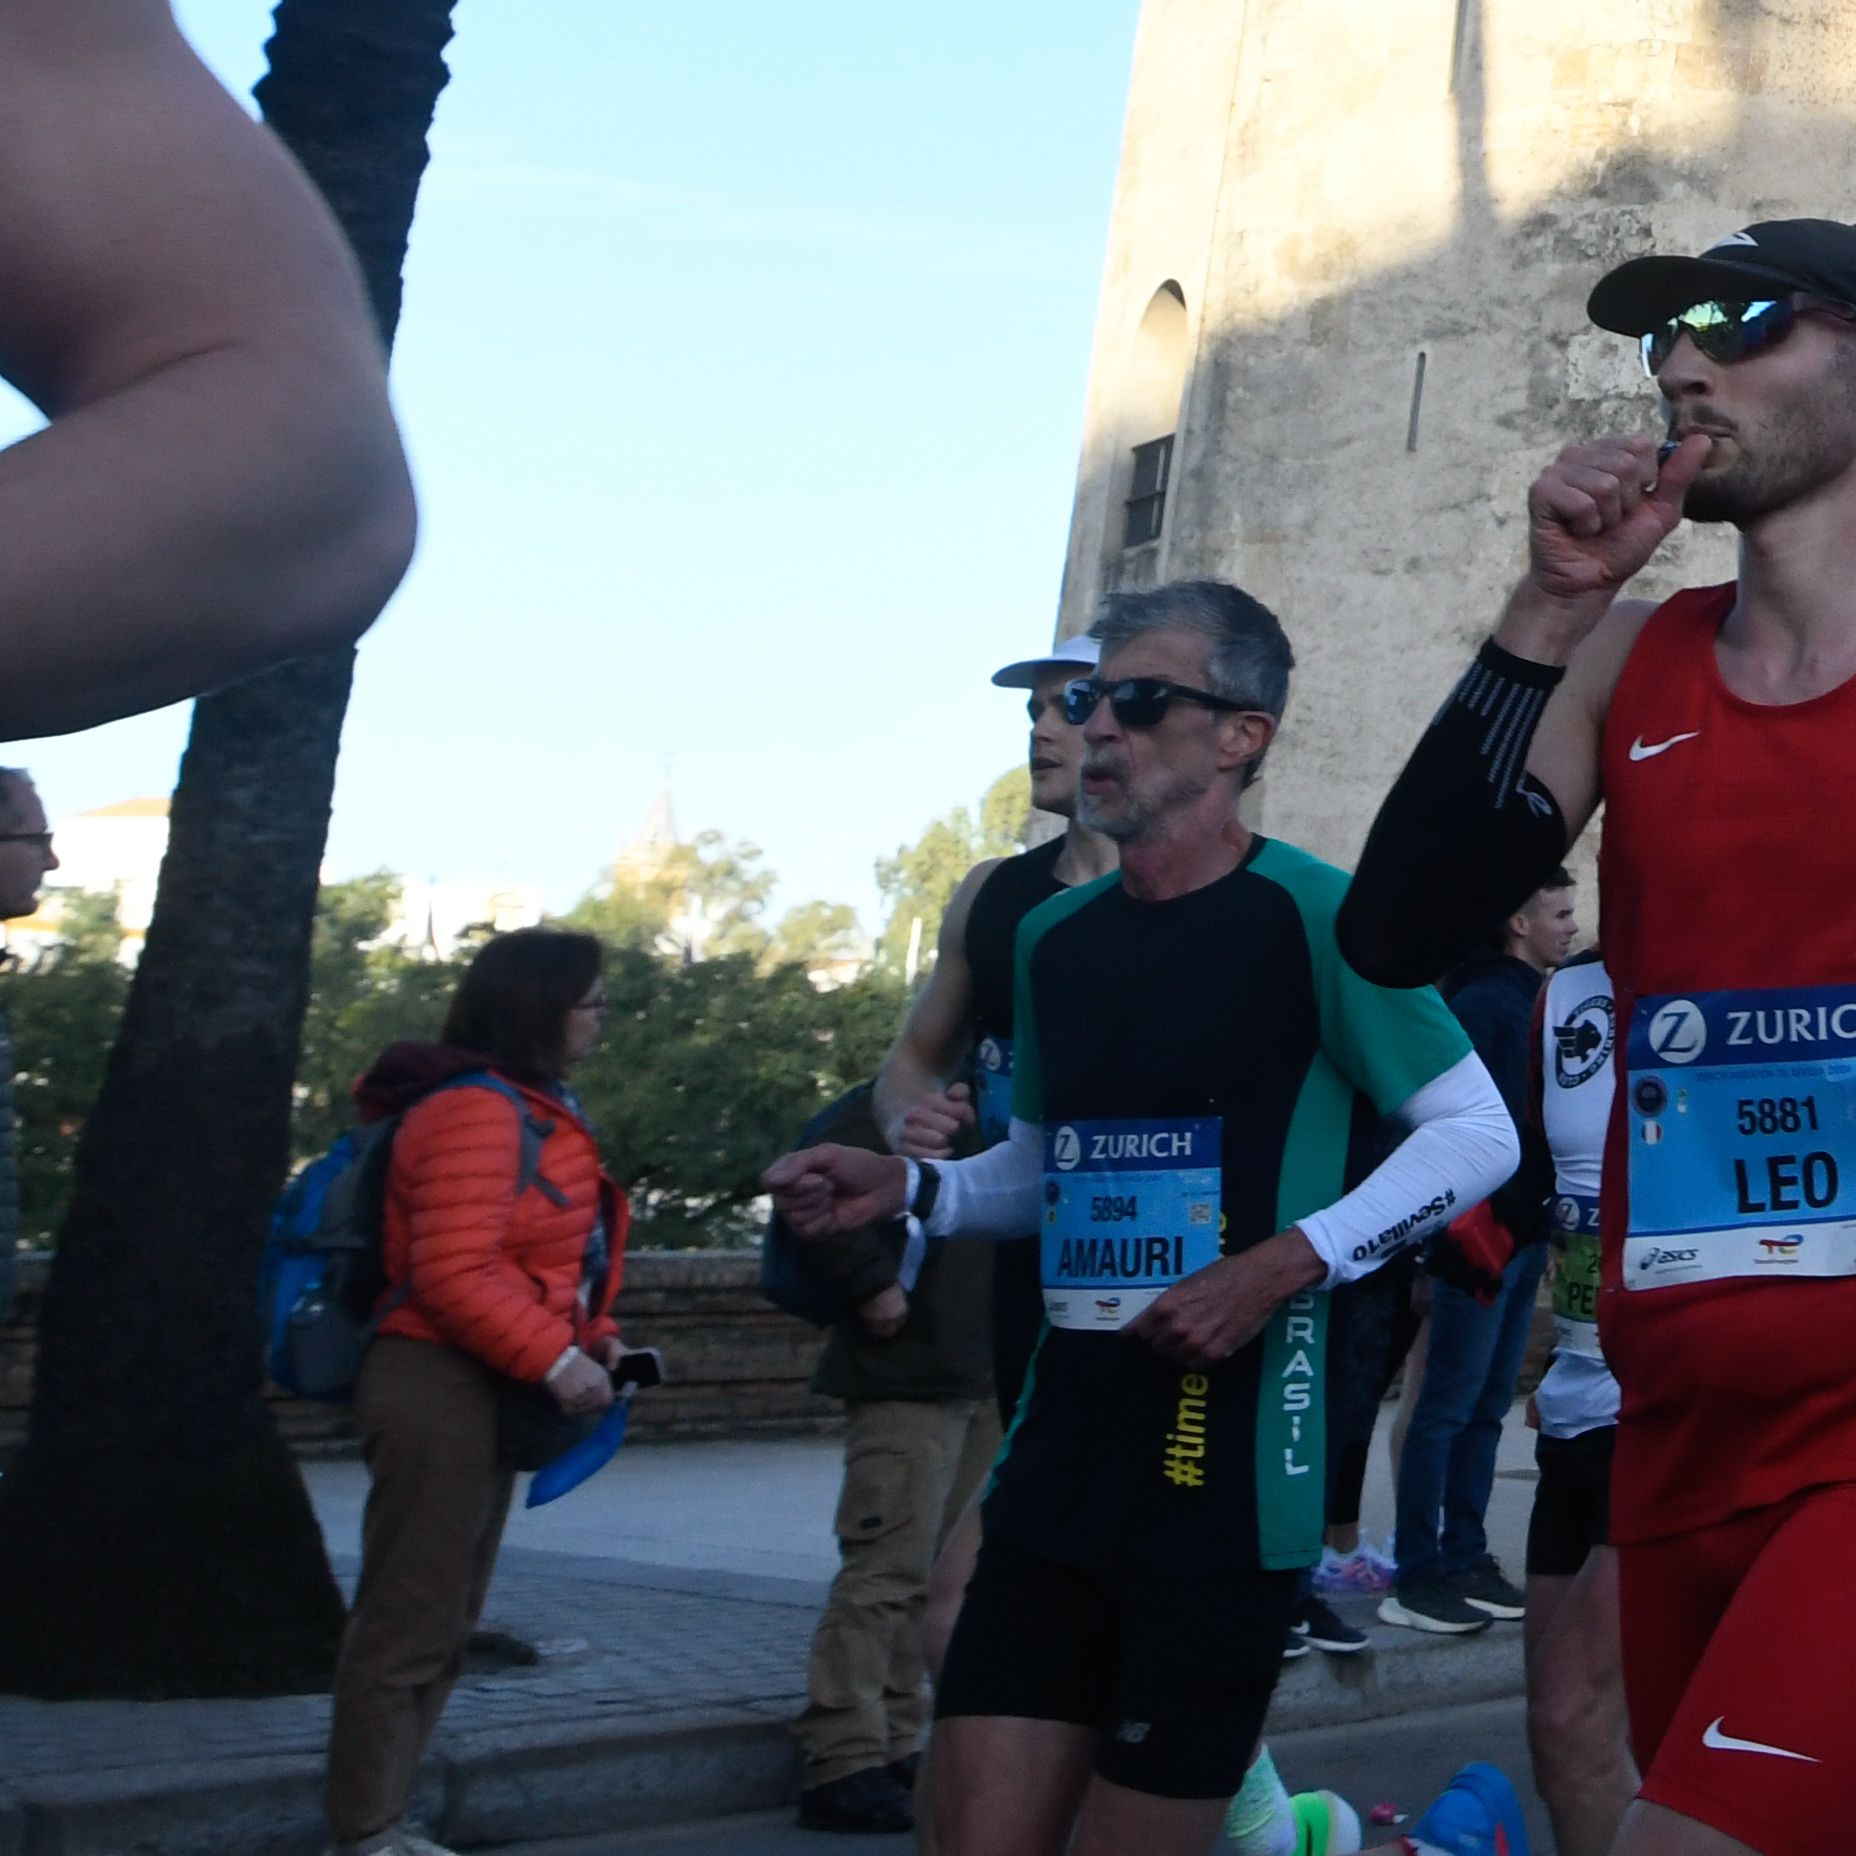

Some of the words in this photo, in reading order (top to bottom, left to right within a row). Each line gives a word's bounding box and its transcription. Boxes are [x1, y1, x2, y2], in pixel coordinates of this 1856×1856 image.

[1737, 1096, 1819, 1136] 5881
[1090, 1131, 1193, 1160] ZURICH
[1734, 1151, 1839, 1214] LEO
[1091, 1196, 1137, 1222] 5894
[1058, 1236, 1183, 1277] AMAURI
